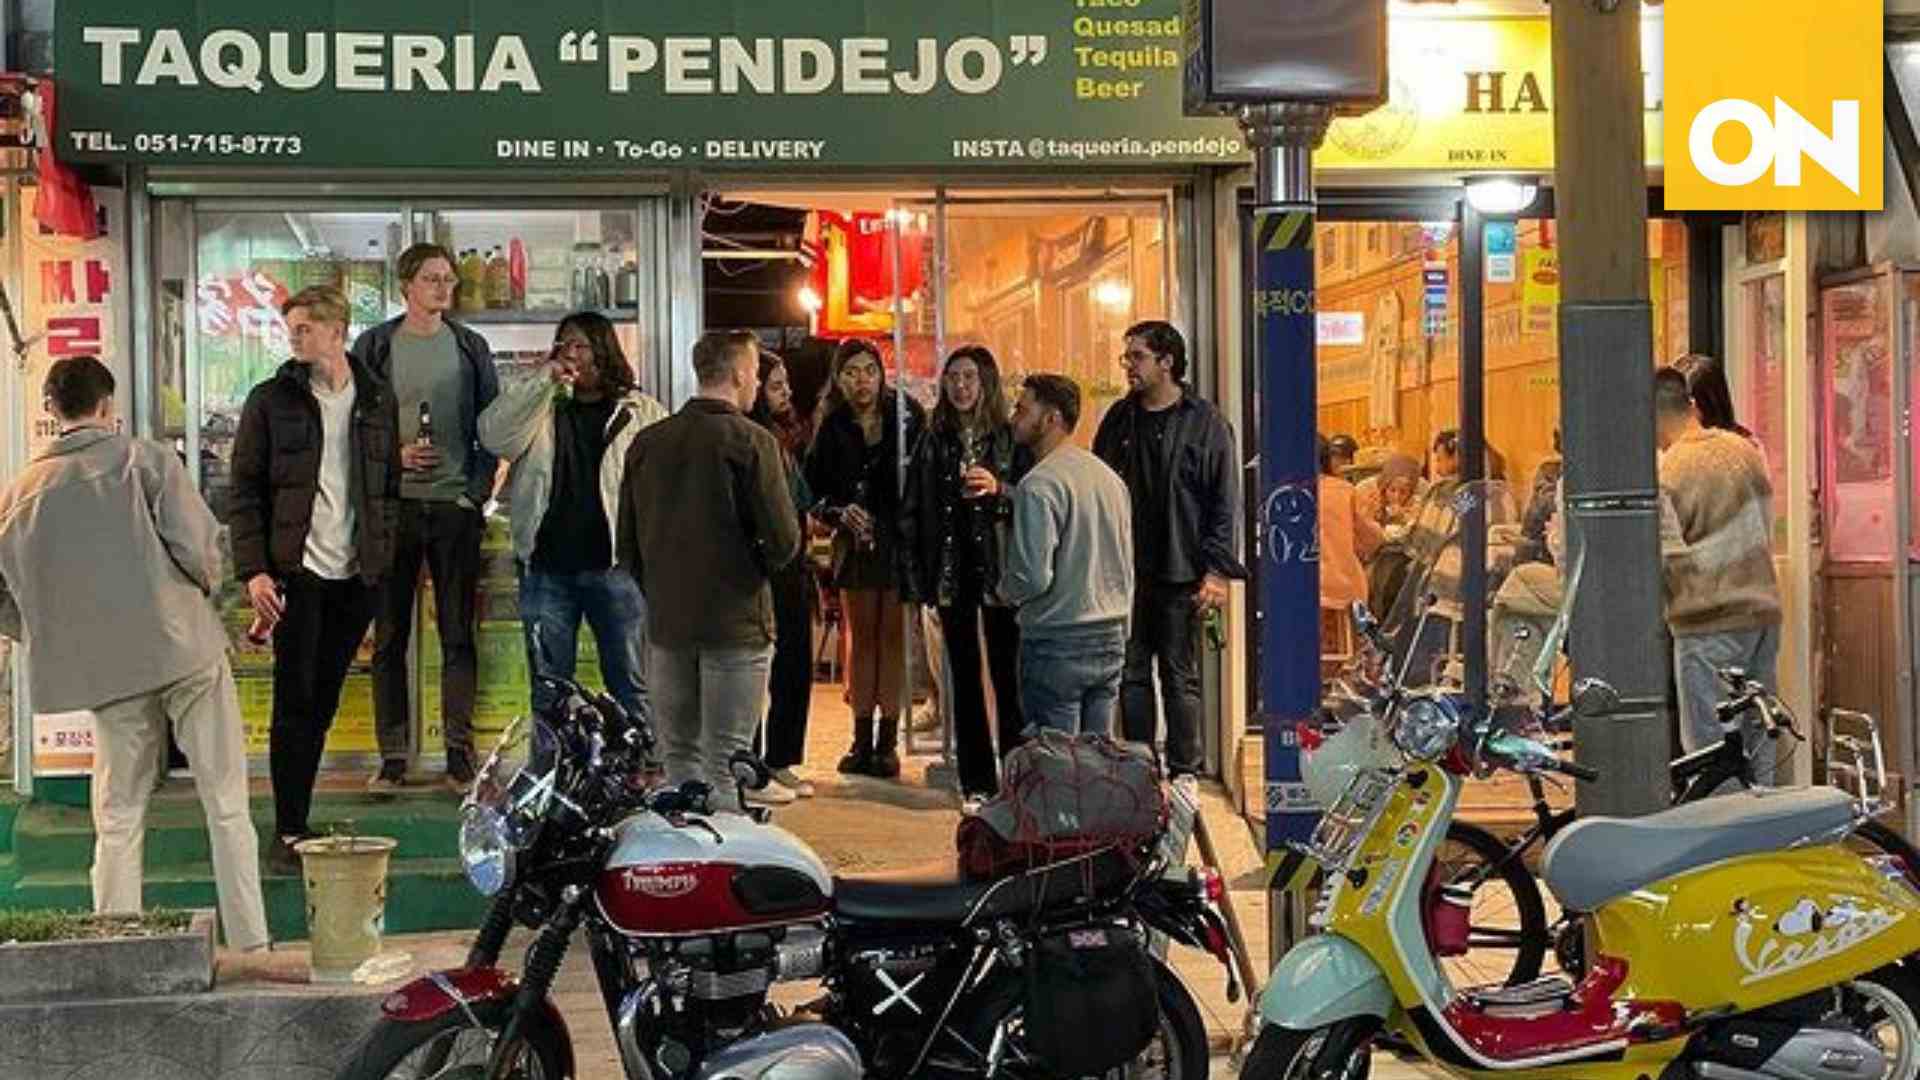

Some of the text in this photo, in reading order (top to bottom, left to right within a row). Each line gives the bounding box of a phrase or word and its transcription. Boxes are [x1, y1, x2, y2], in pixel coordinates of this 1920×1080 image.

[83, 27, 541, 93] TAQUERIA
[1074, 45, 1179, 71] Tequila
[1076, 77, 1143, 98] Beer
[70, 131, 302, 154] TEL. 051-715-8773
[497, 139, 825, 159] DINE IN To-Go DELIVERY
[952, 140, 1024, 157] INSTA
